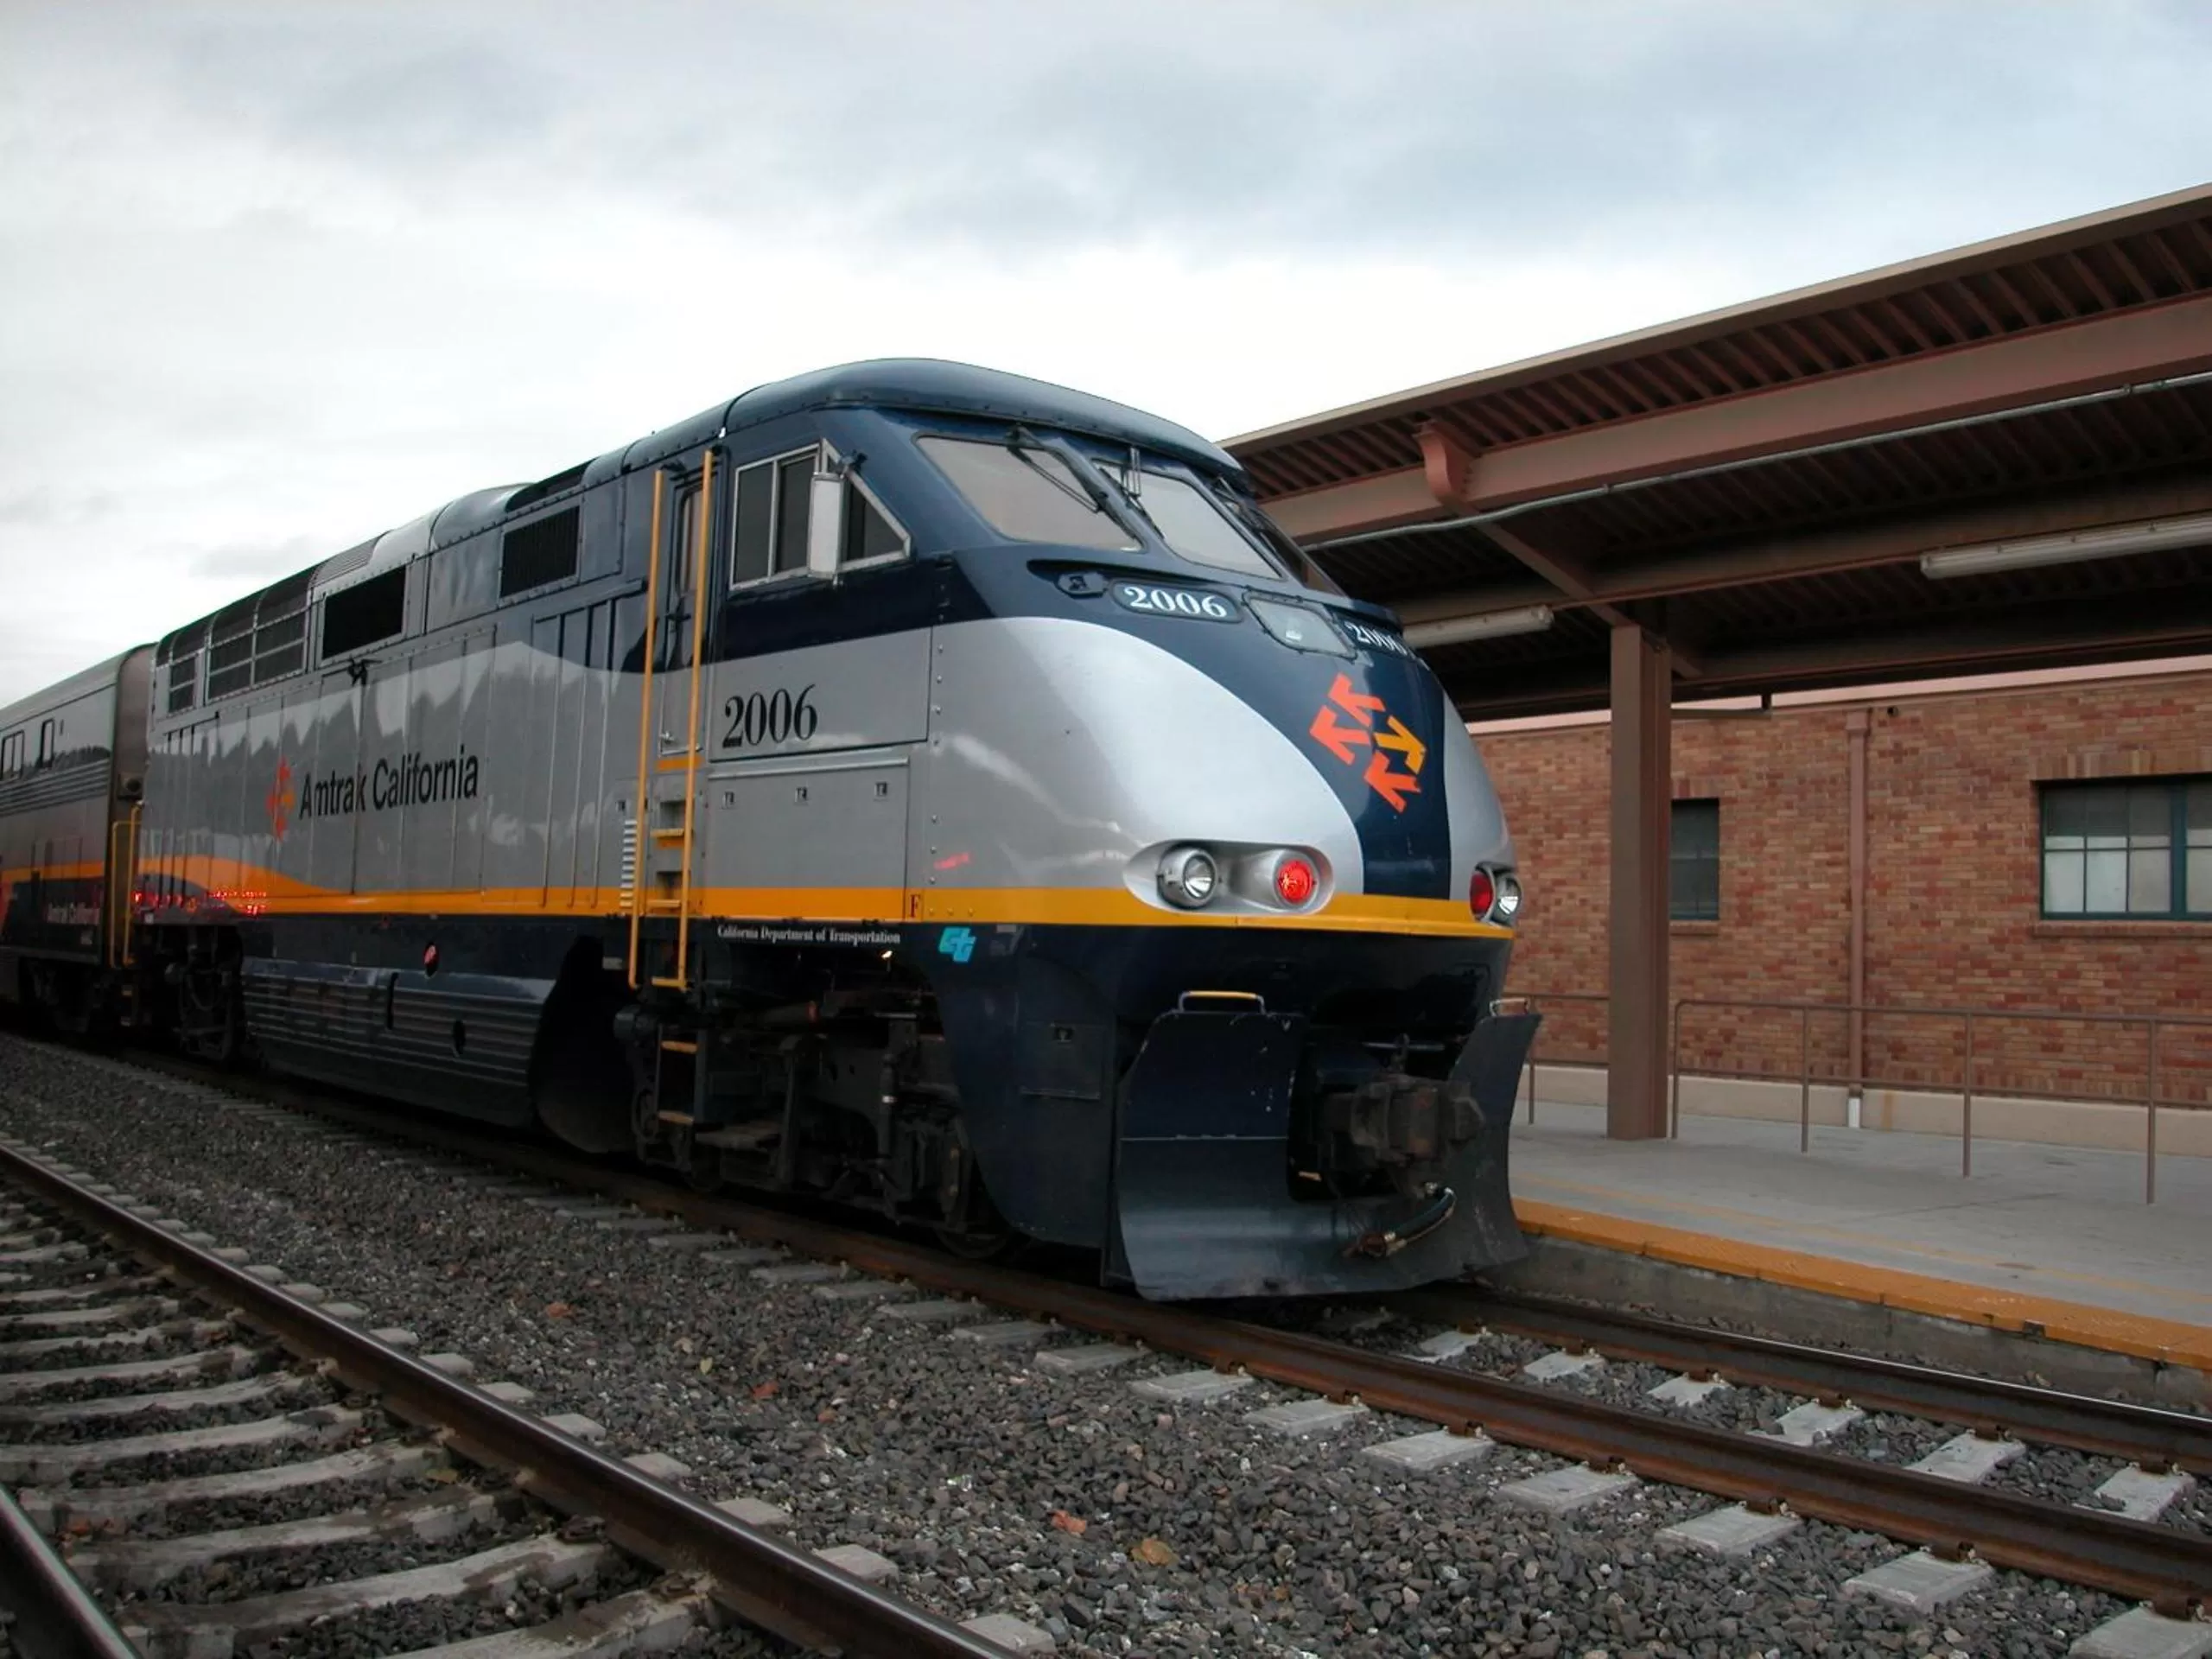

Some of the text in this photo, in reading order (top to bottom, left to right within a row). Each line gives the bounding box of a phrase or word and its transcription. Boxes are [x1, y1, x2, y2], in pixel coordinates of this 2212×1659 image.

[1123, 586, 1227, 618] 2006
[722, 683, 818, 749] 2006
[299, 743, 479, 820] Amtrak California
[908, 893, 921, 918] F
[717, 925, 900, 946] California Department of Transportation
